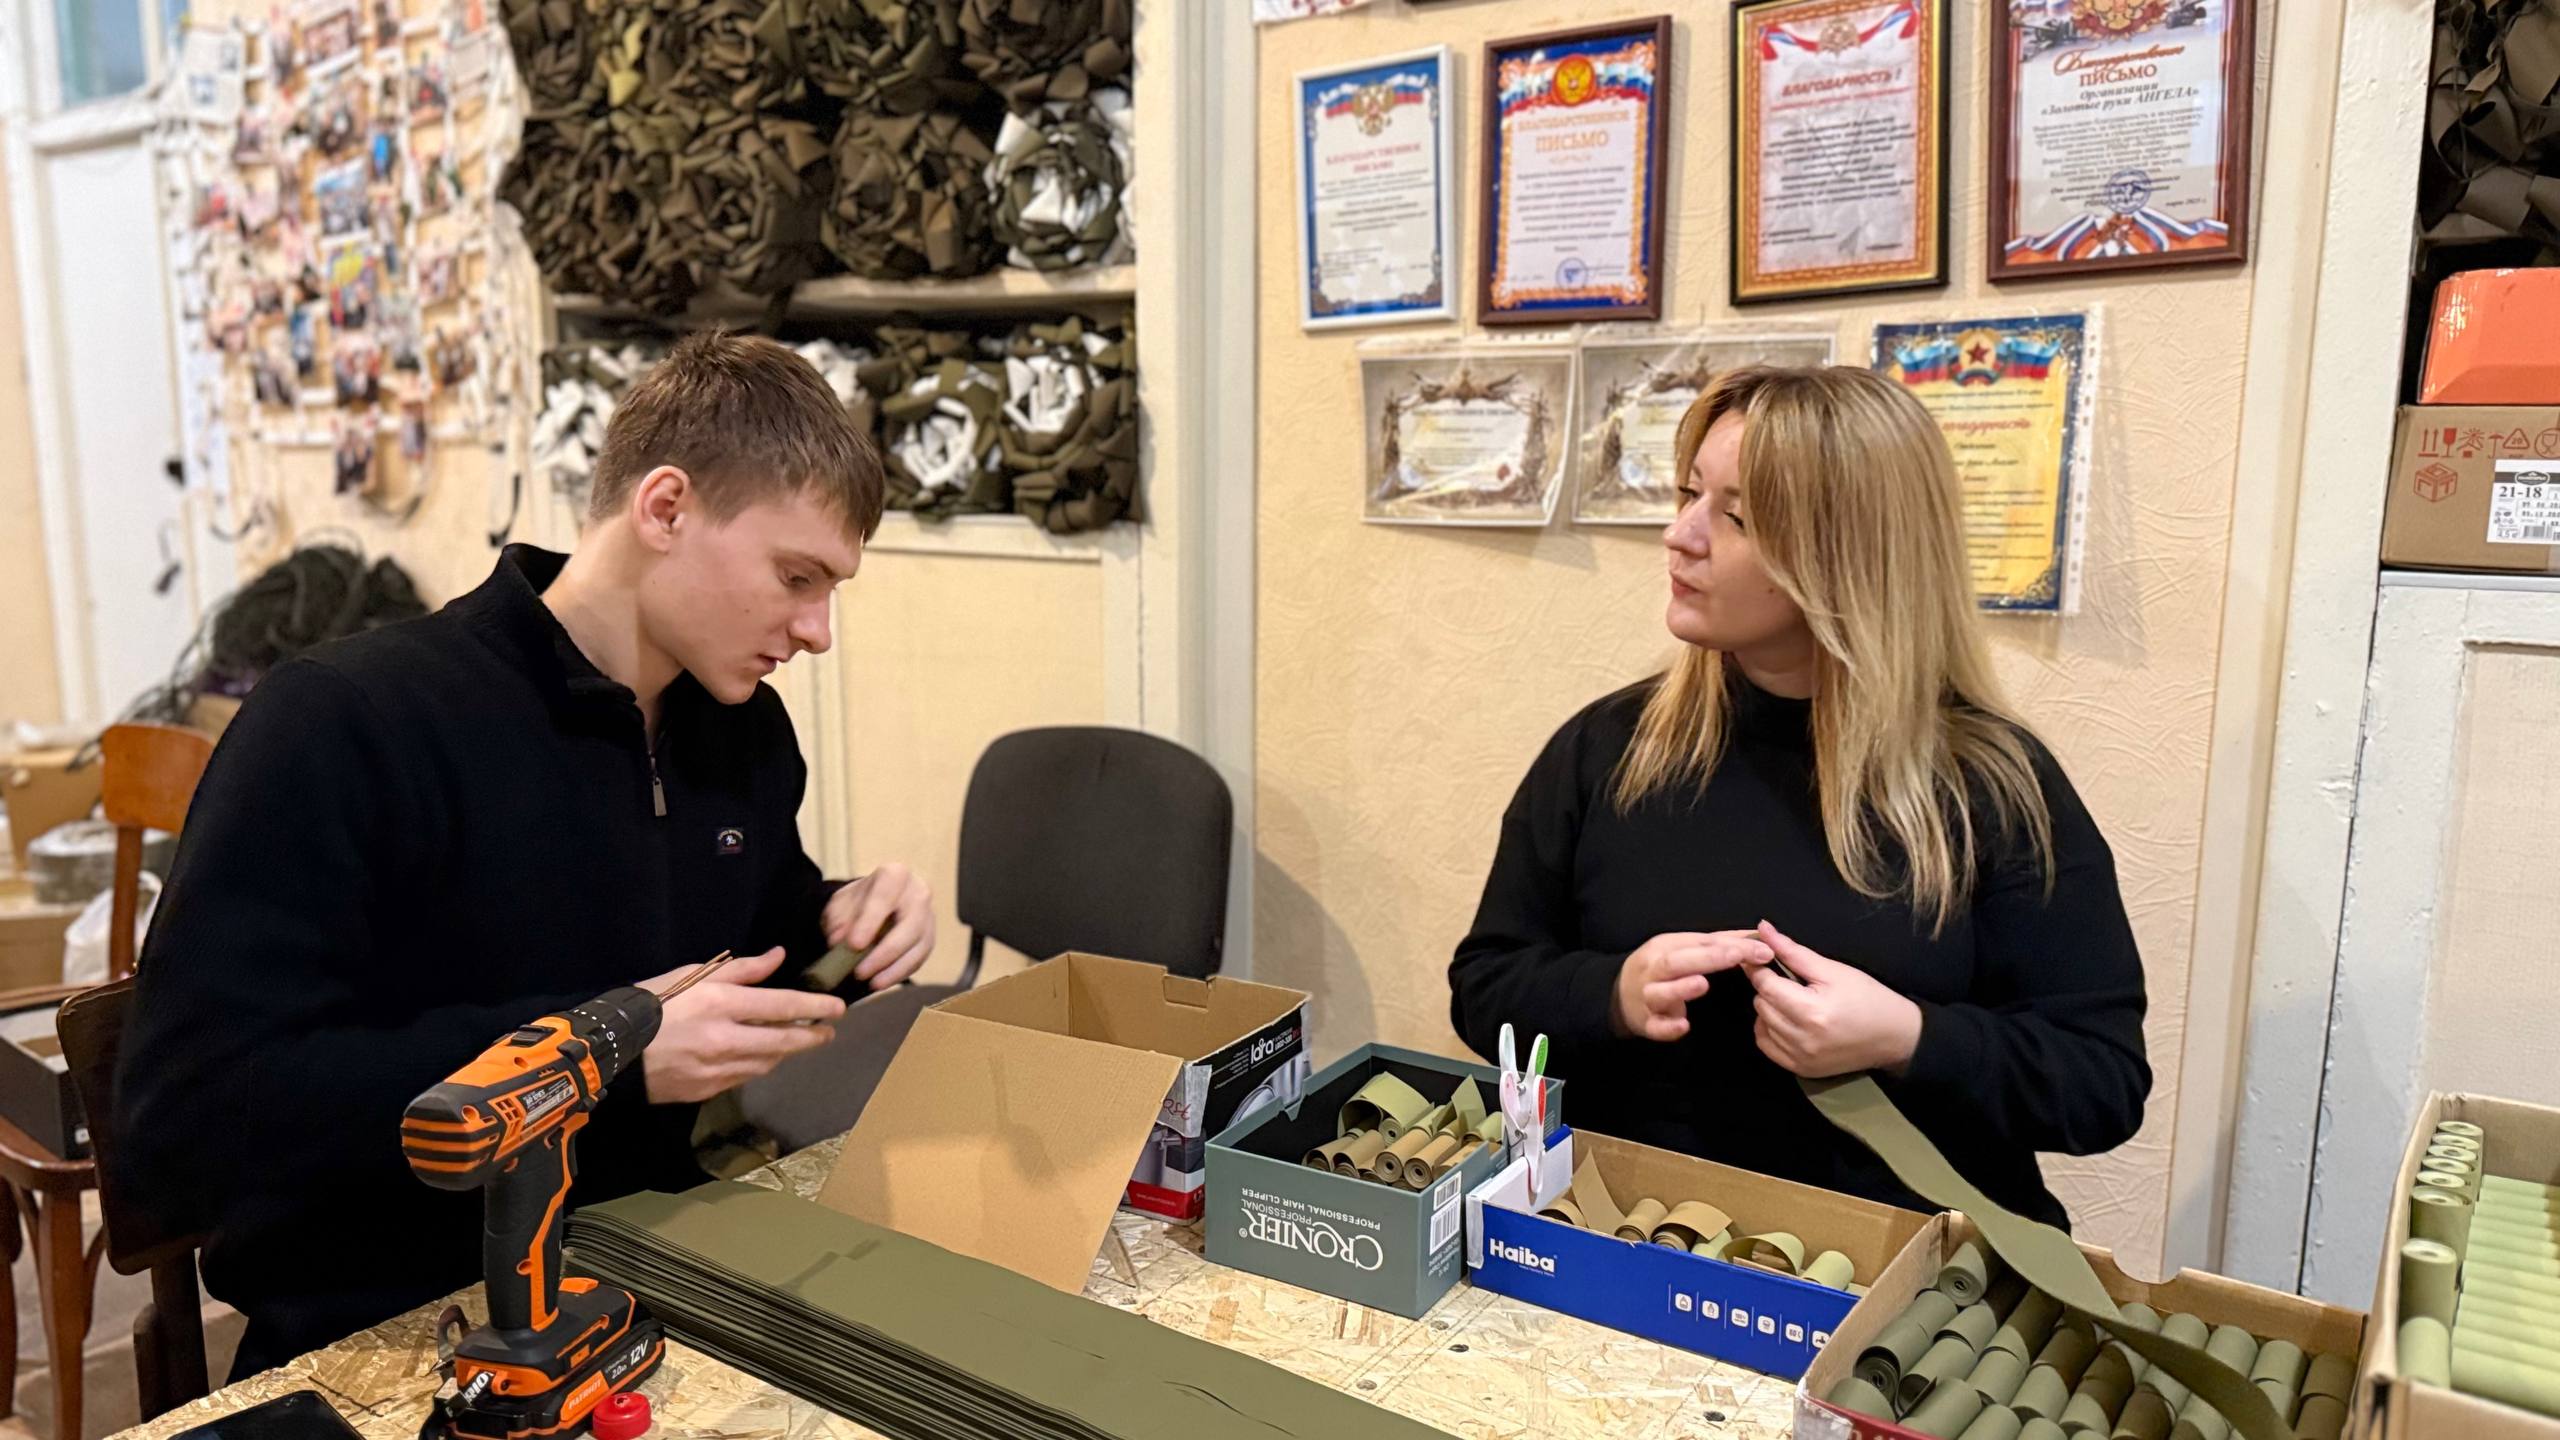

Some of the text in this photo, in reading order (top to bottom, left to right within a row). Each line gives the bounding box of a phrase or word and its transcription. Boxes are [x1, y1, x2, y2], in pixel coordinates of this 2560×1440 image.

[2080, 64, 2158, 87] ПИСЬМО
[1535, 132, 1609, 154] ПИСЬМО
[2499, 486, 2542, 498] 21-18
[1241, 1199, 1312, 1225] PROFESSIONAL
[1242, 1187, 1381, 1231] PROFESSIONAL HAIR CLIPPER
[1489, 1238, 1556, 1273] Haiba
[630, 1339, 648, 1366] 12V
